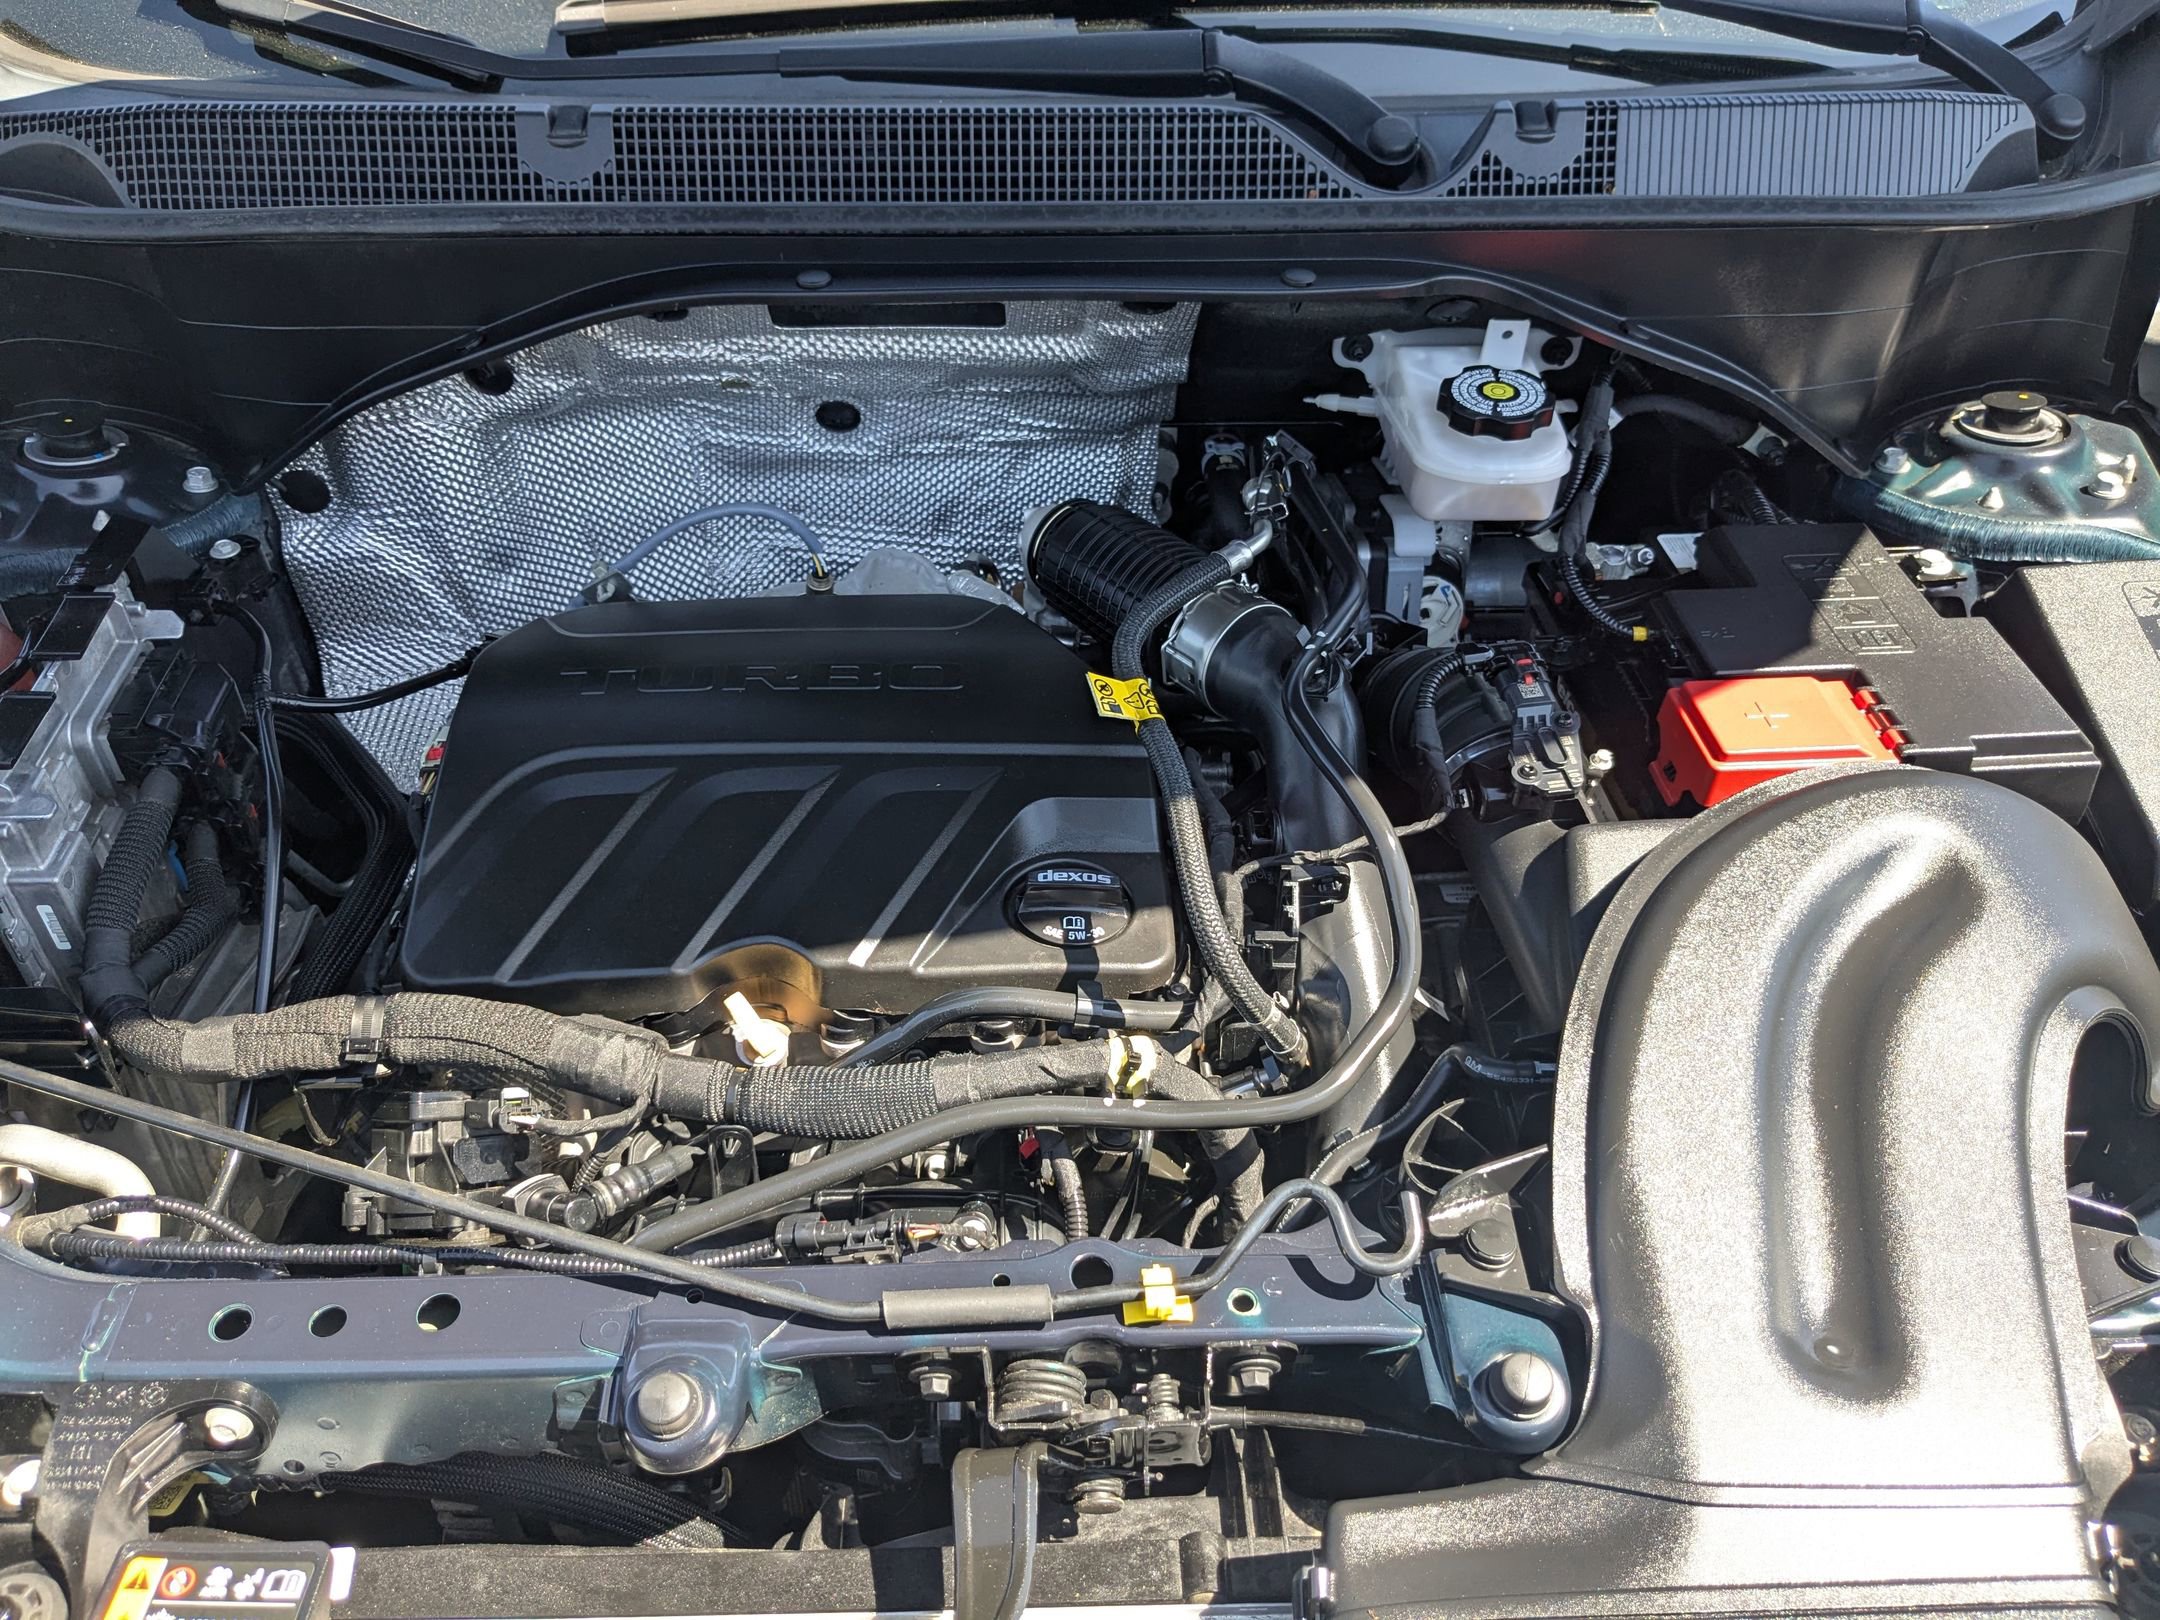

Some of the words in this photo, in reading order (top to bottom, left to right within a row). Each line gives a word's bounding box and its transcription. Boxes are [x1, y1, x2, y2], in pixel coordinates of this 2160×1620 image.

[560, 663, 965, 695] TURBO
[1037, 869, 1112, 884] dexos
[1042, 925, 1064, 939] SAE
[1067, 926, 1106, 940] 5W-30
